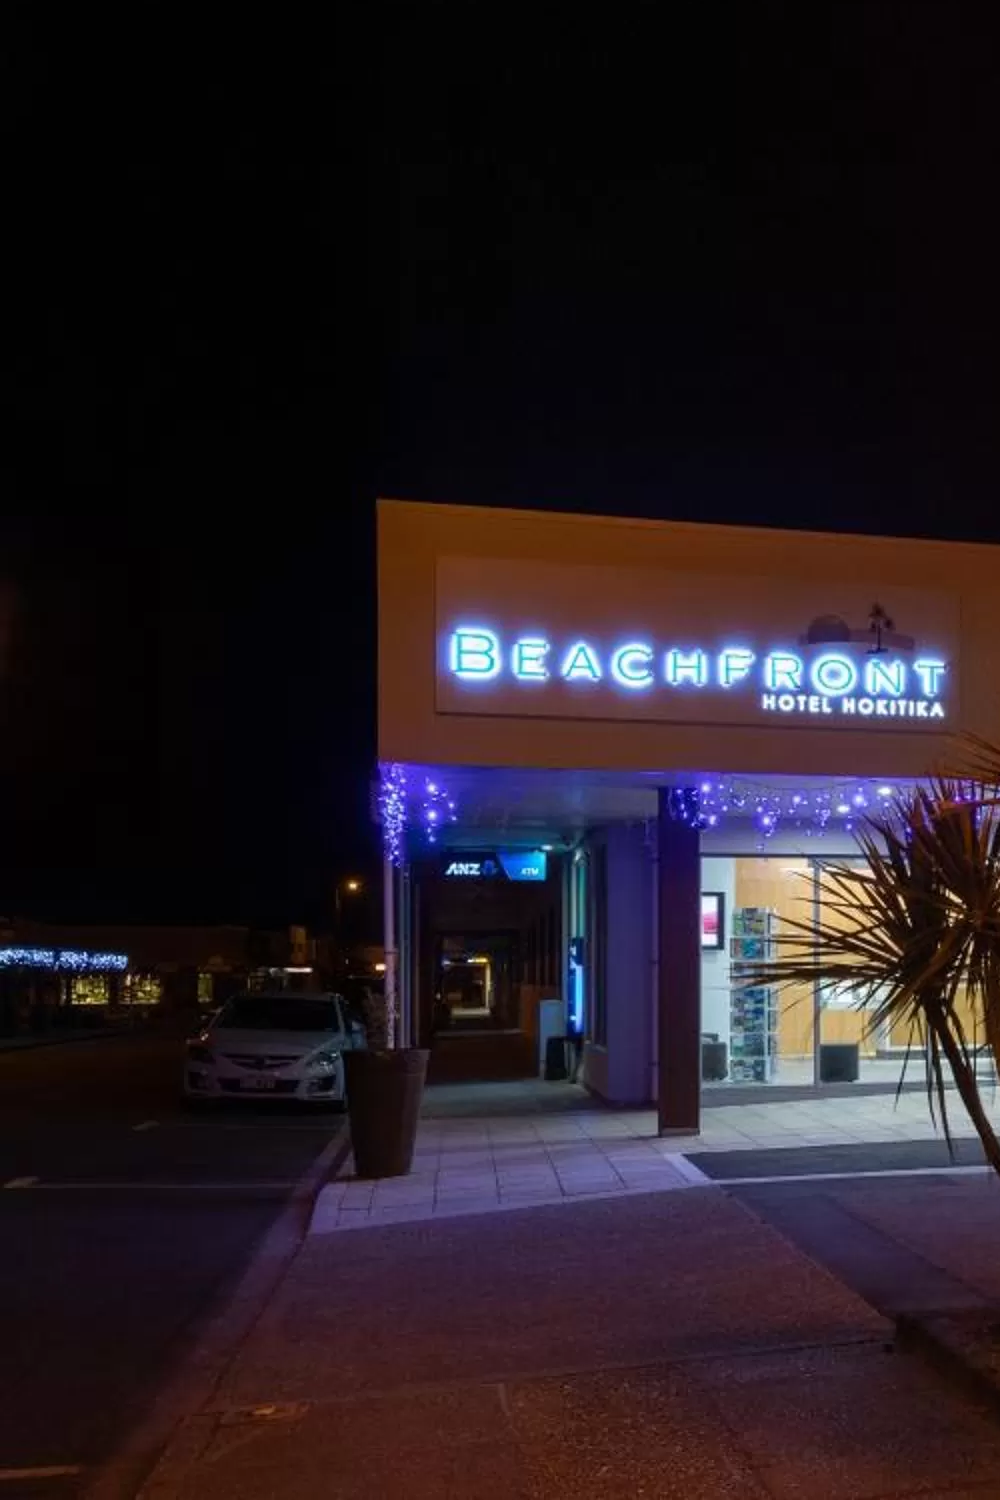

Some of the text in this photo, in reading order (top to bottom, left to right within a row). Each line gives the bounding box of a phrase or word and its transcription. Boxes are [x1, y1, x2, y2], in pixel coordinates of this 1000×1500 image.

[448, 626, 948, 697] BEACHFRONT
[762, 694, 945, 718] HOTEL HOKITIKA
[445, 862, 481, 876] ANZ
